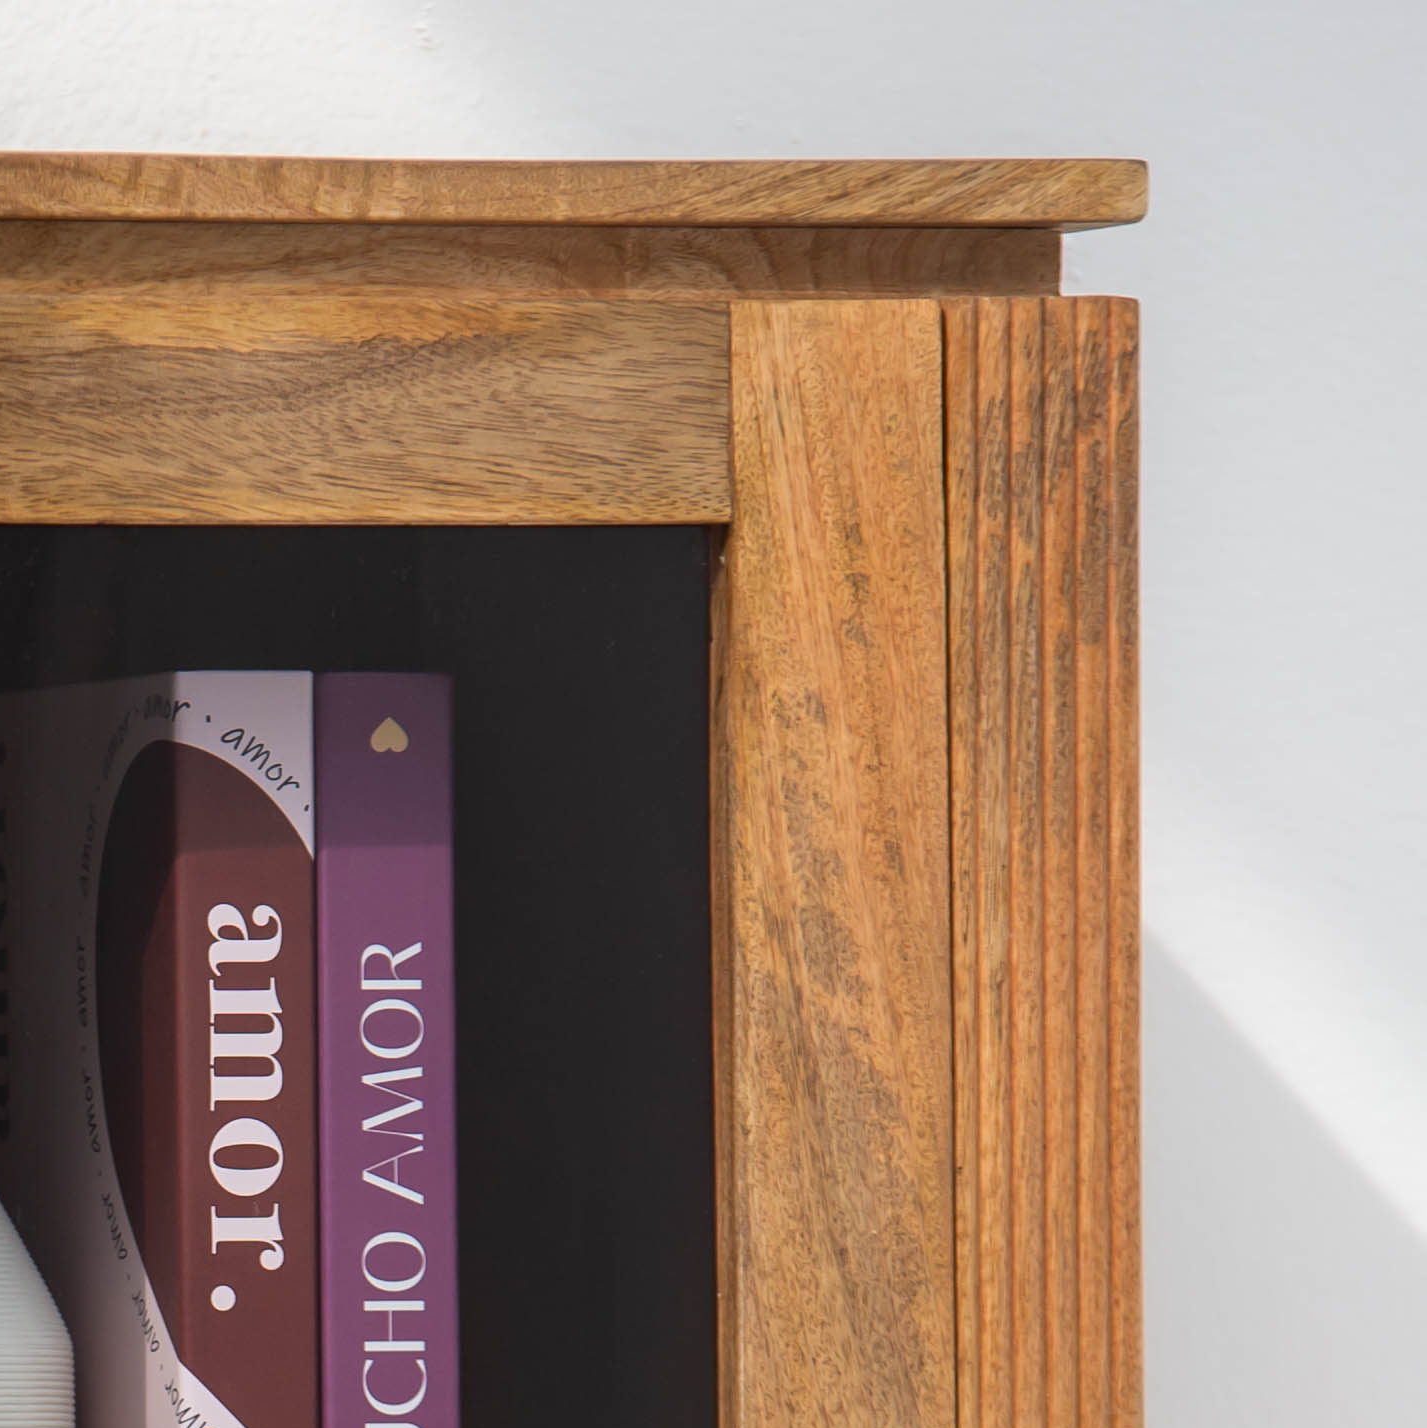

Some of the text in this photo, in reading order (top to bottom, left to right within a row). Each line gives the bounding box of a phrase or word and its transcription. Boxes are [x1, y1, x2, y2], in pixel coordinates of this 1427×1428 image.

[220, 727, 300, 792] amor
[207, 903, 286, 1312] amor.
[359, 941, 426, 1206] AMOR
